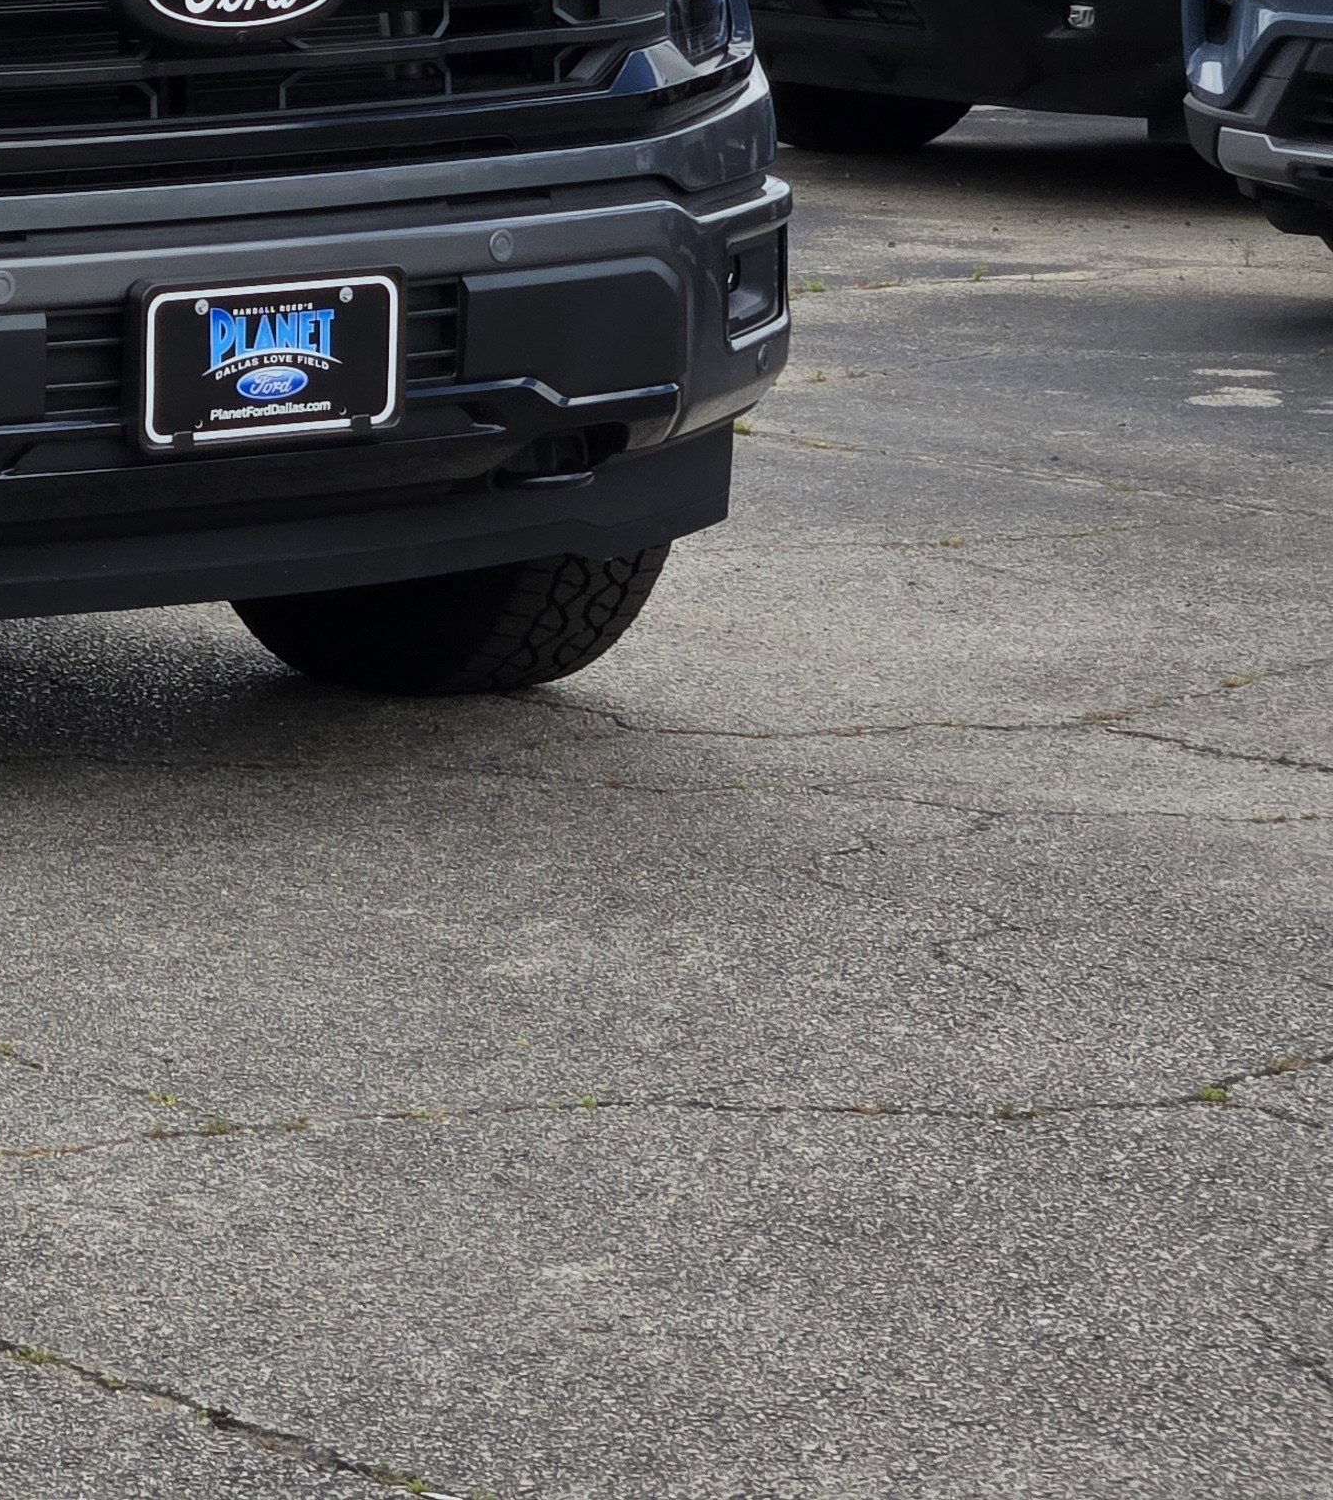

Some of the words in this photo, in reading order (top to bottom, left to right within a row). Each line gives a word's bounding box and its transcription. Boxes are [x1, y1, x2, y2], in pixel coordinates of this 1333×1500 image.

[210, 308, 334, 369] PLANET
[215, 358, 259, 380] DALLAS
[263, 354, 293, 365] LOVE
[297, 356, 329, 370] FIELD
[249, 374, 293, 396] Ford
[210, 401, 331, 421] PlanetFordDallas.com
